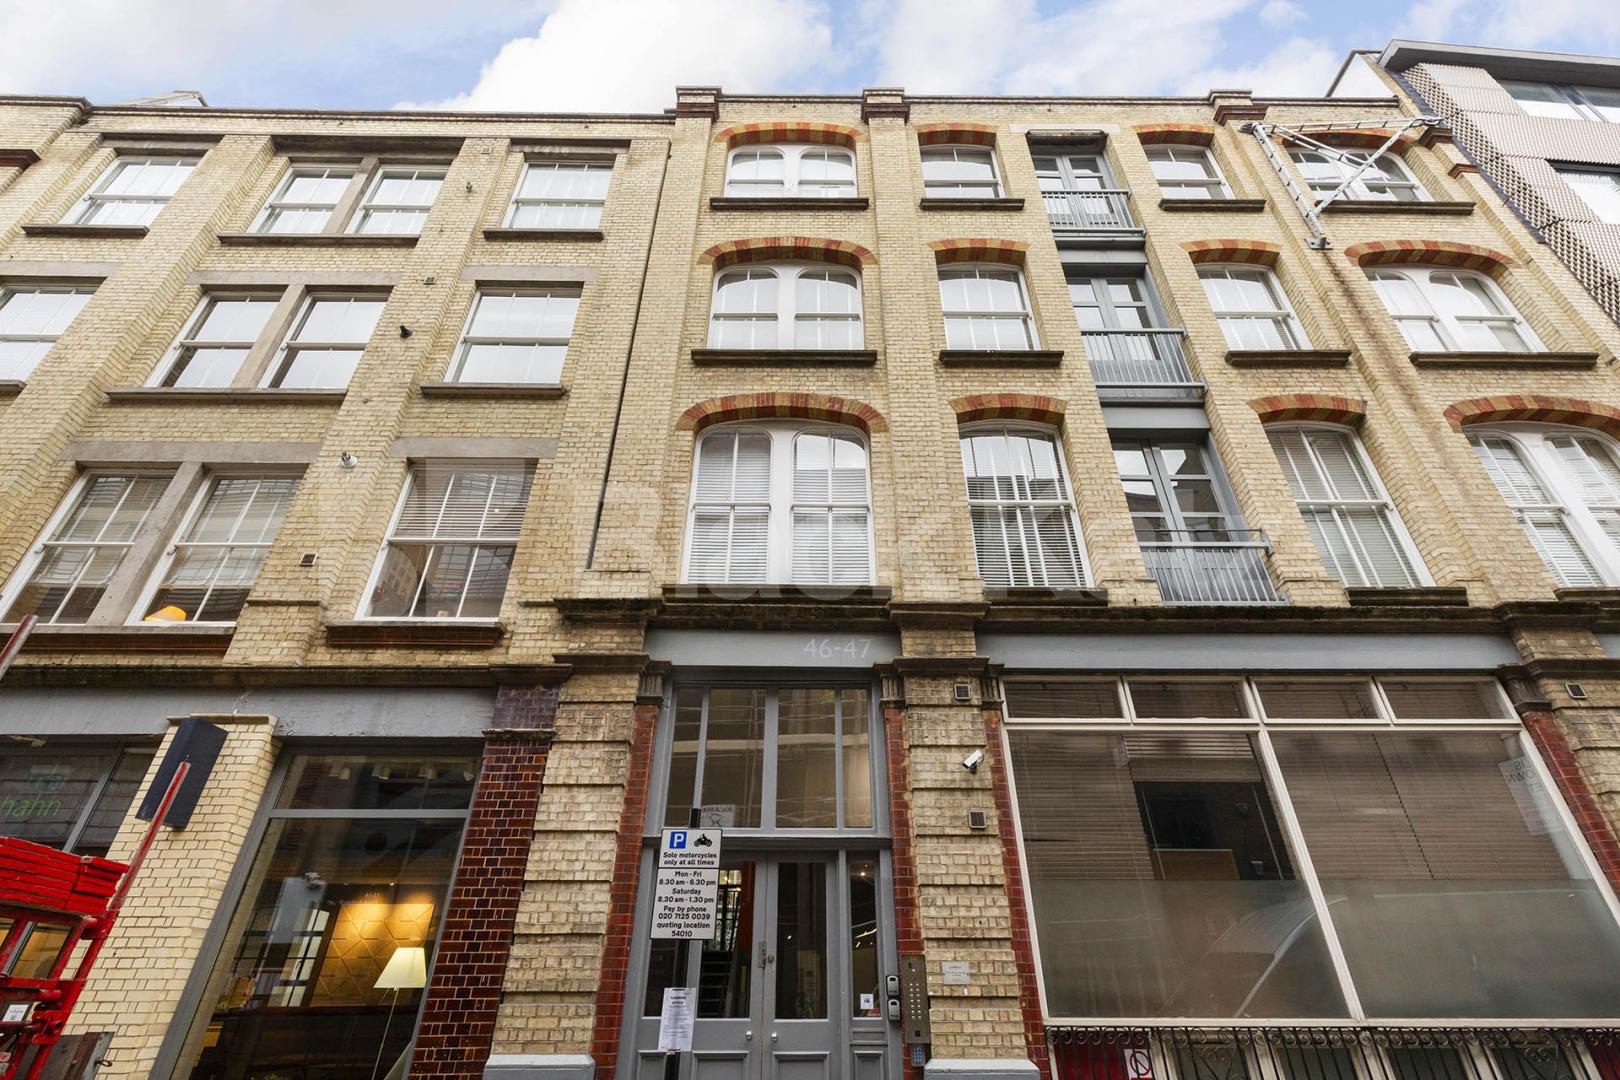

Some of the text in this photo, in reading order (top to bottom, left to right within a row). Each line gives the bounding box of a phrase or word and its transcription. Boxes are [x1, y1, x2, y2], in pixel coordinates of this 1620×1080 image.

[803, 638, 873, 658] 46-47
[673, 833, 685, 848] P
[663, 905, 675, 913] Pay
[677, 905, 685, 913] by
